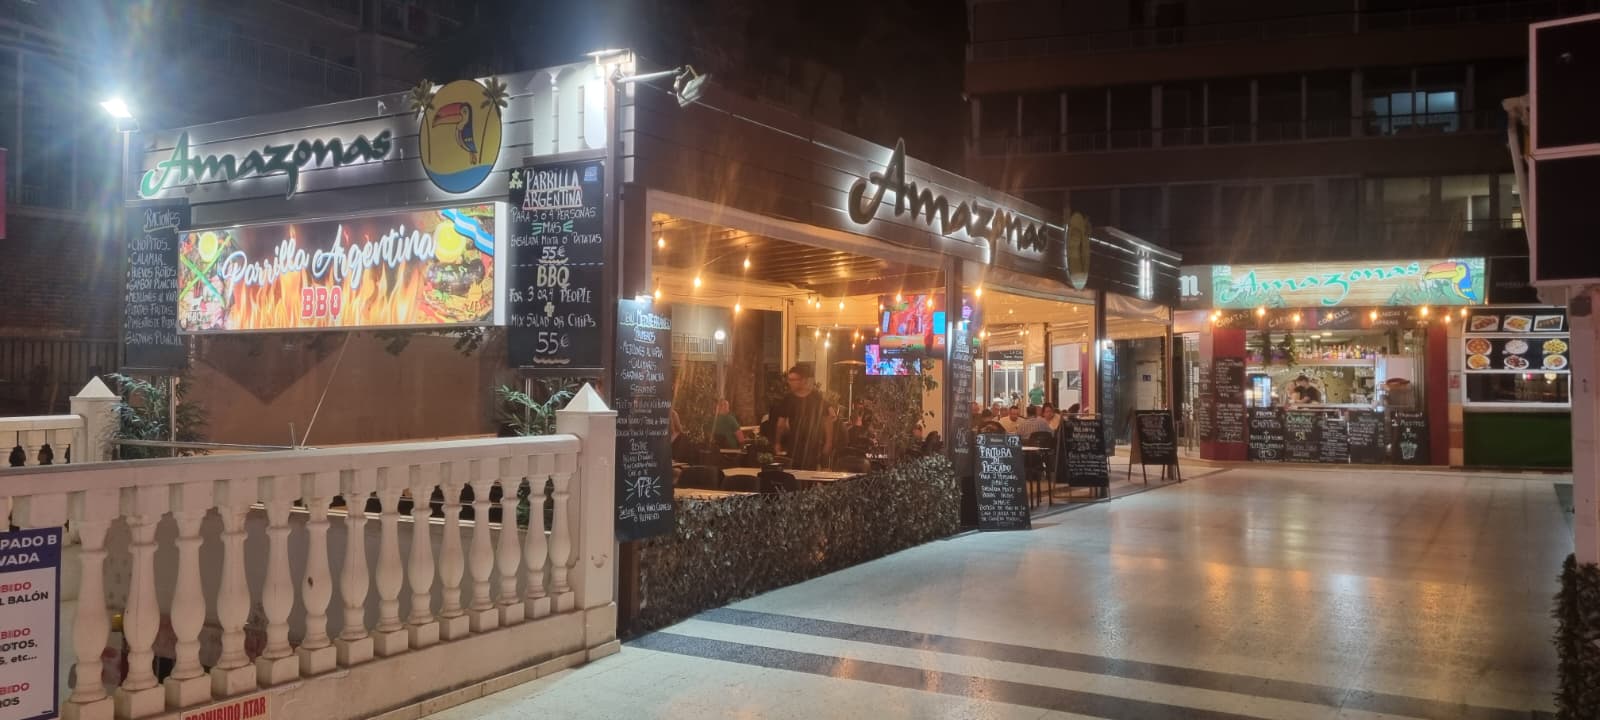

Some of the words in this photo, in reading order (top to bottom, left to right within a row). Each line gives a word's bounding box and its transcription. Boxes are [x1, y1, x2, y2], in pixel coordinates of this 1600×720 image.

[139, 130, 391, 199] Amazonas
[523, 167, 579, 190] PARRILLA
[848, 137, 1049, 266] Amazonas
[511, 207, 530, 222] PARA
[533, 210, 538, 221] 3
[556, 207, 596, 220] PERSONAS
[222, 233, 309, 299] Parrilla
[312, 224, 438, 290] Argentina
[541, 246, 566, 259] 55€
[537, 265, 570, 287] BBQ
[1221, 261, 1421, 305] Amazonas
[301, 286, 343, 320] BBQ
[528, 286, 534, 302] 3
[560, 287, 592, 303] PEOPLE
[536, 332, 568, 354] 55€
[48, 535, 57, 545] B
[8, 590, 49, 605] BALÓN
[185, 703, 240, 720] HIBIDO
[243, 696, 265, 719] ATAR
